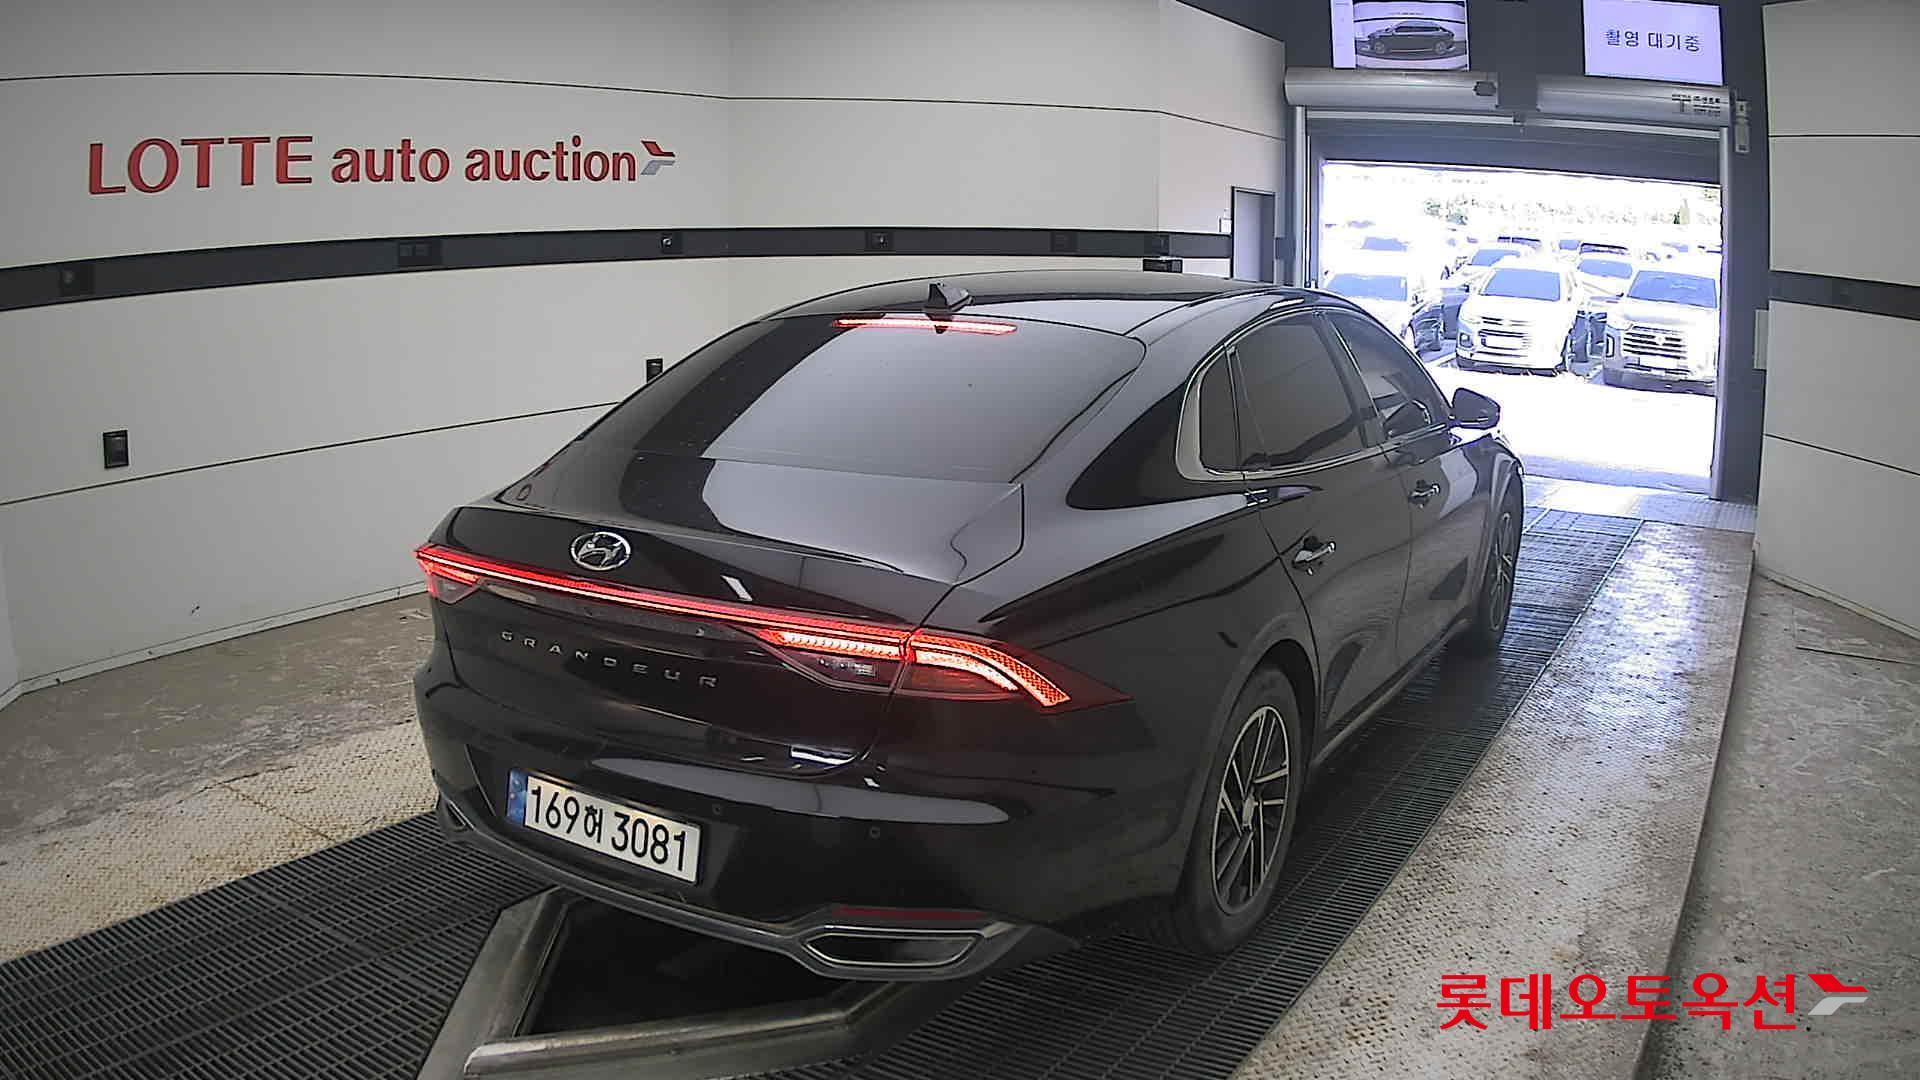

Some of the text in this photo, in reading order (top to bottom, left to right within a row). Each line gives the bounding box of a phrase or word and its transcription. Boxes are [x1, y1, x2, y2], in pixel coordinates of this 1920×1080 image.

[1603, 29, 1700, 52] 촬영 대기중
[88, 135, 637, 195] LOTTE auto auction
[501, 630, 719, 688] GRANDEUR
[611, 811, 689, 872] 3081
